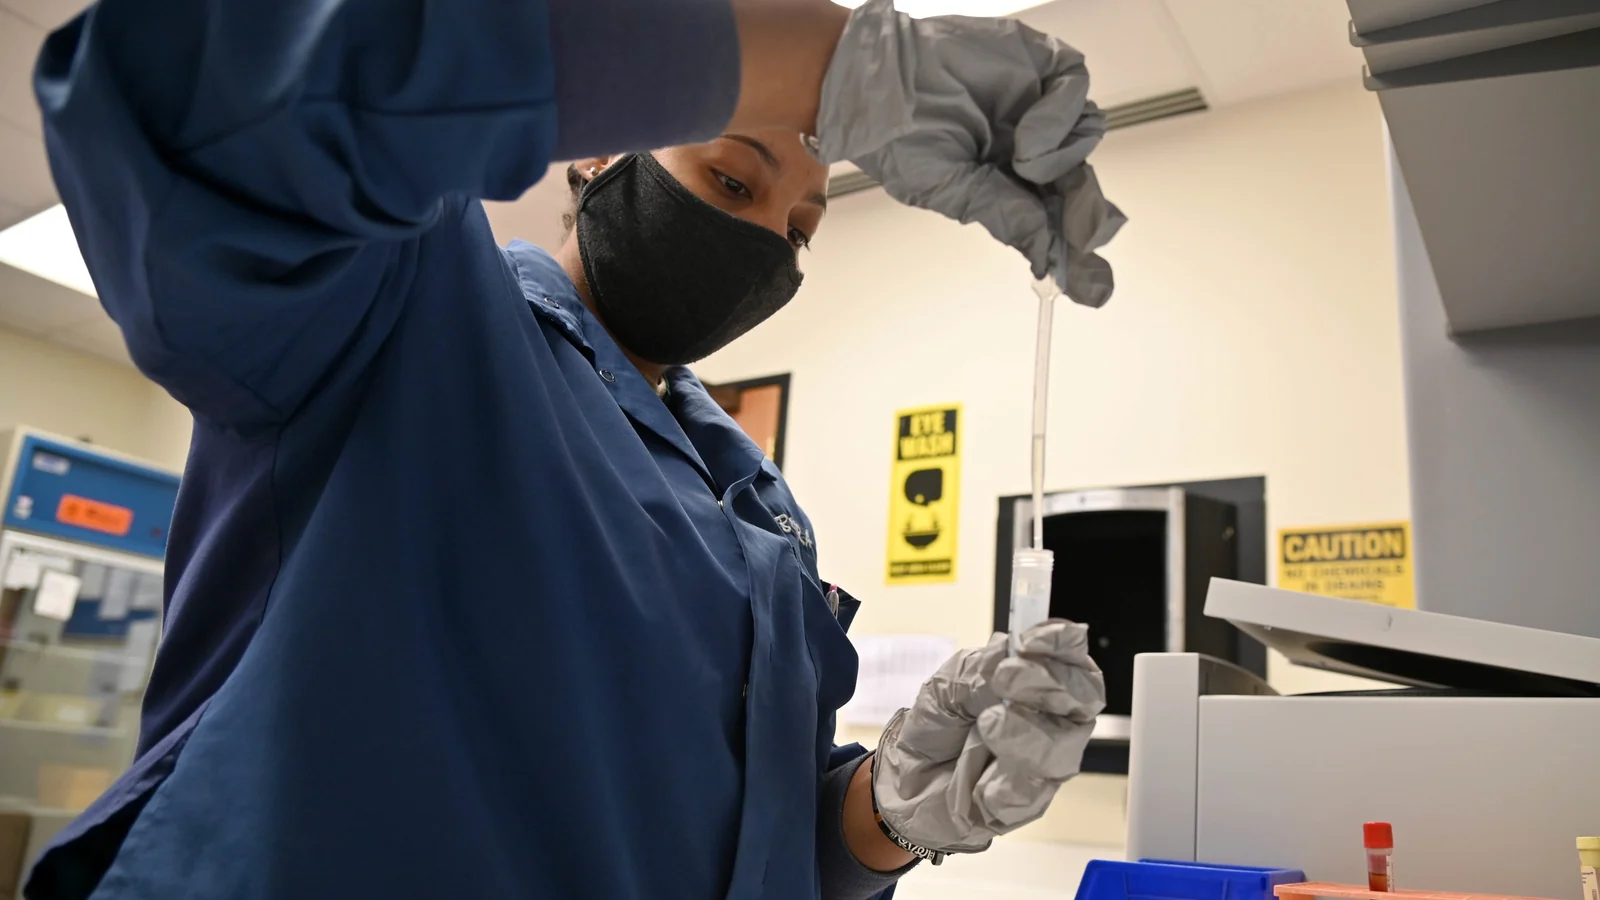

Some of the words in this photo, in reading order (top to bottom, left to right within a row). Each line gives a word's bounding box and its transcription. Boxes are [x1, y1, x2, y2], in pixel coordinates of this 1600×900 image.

[910, 411, 946, 437] EYE
[901, 431, 954, 459] WASH
[1285, 530, 1402, 561] CAUTION
